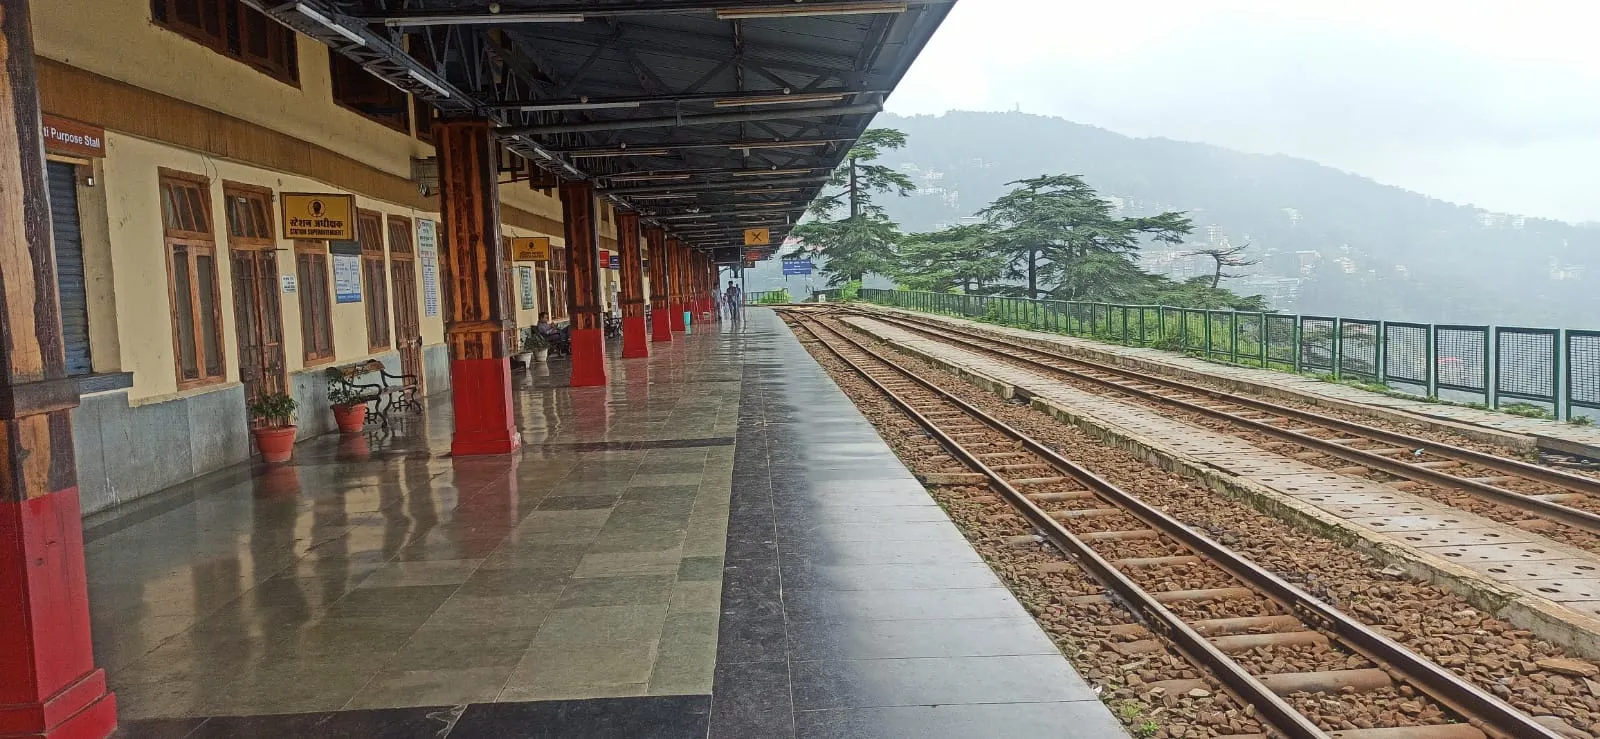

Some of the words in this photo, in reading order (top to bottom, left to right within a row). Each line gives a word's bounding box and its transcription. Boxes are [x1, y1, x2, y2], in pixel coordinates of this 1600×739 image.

[51, 128, 83, 144] Purpose
[84, 135, 100, 147] Stall
[290, 216, 312, 227] स्टेशन
[314, 217, 343, 228] अधीक्षक
